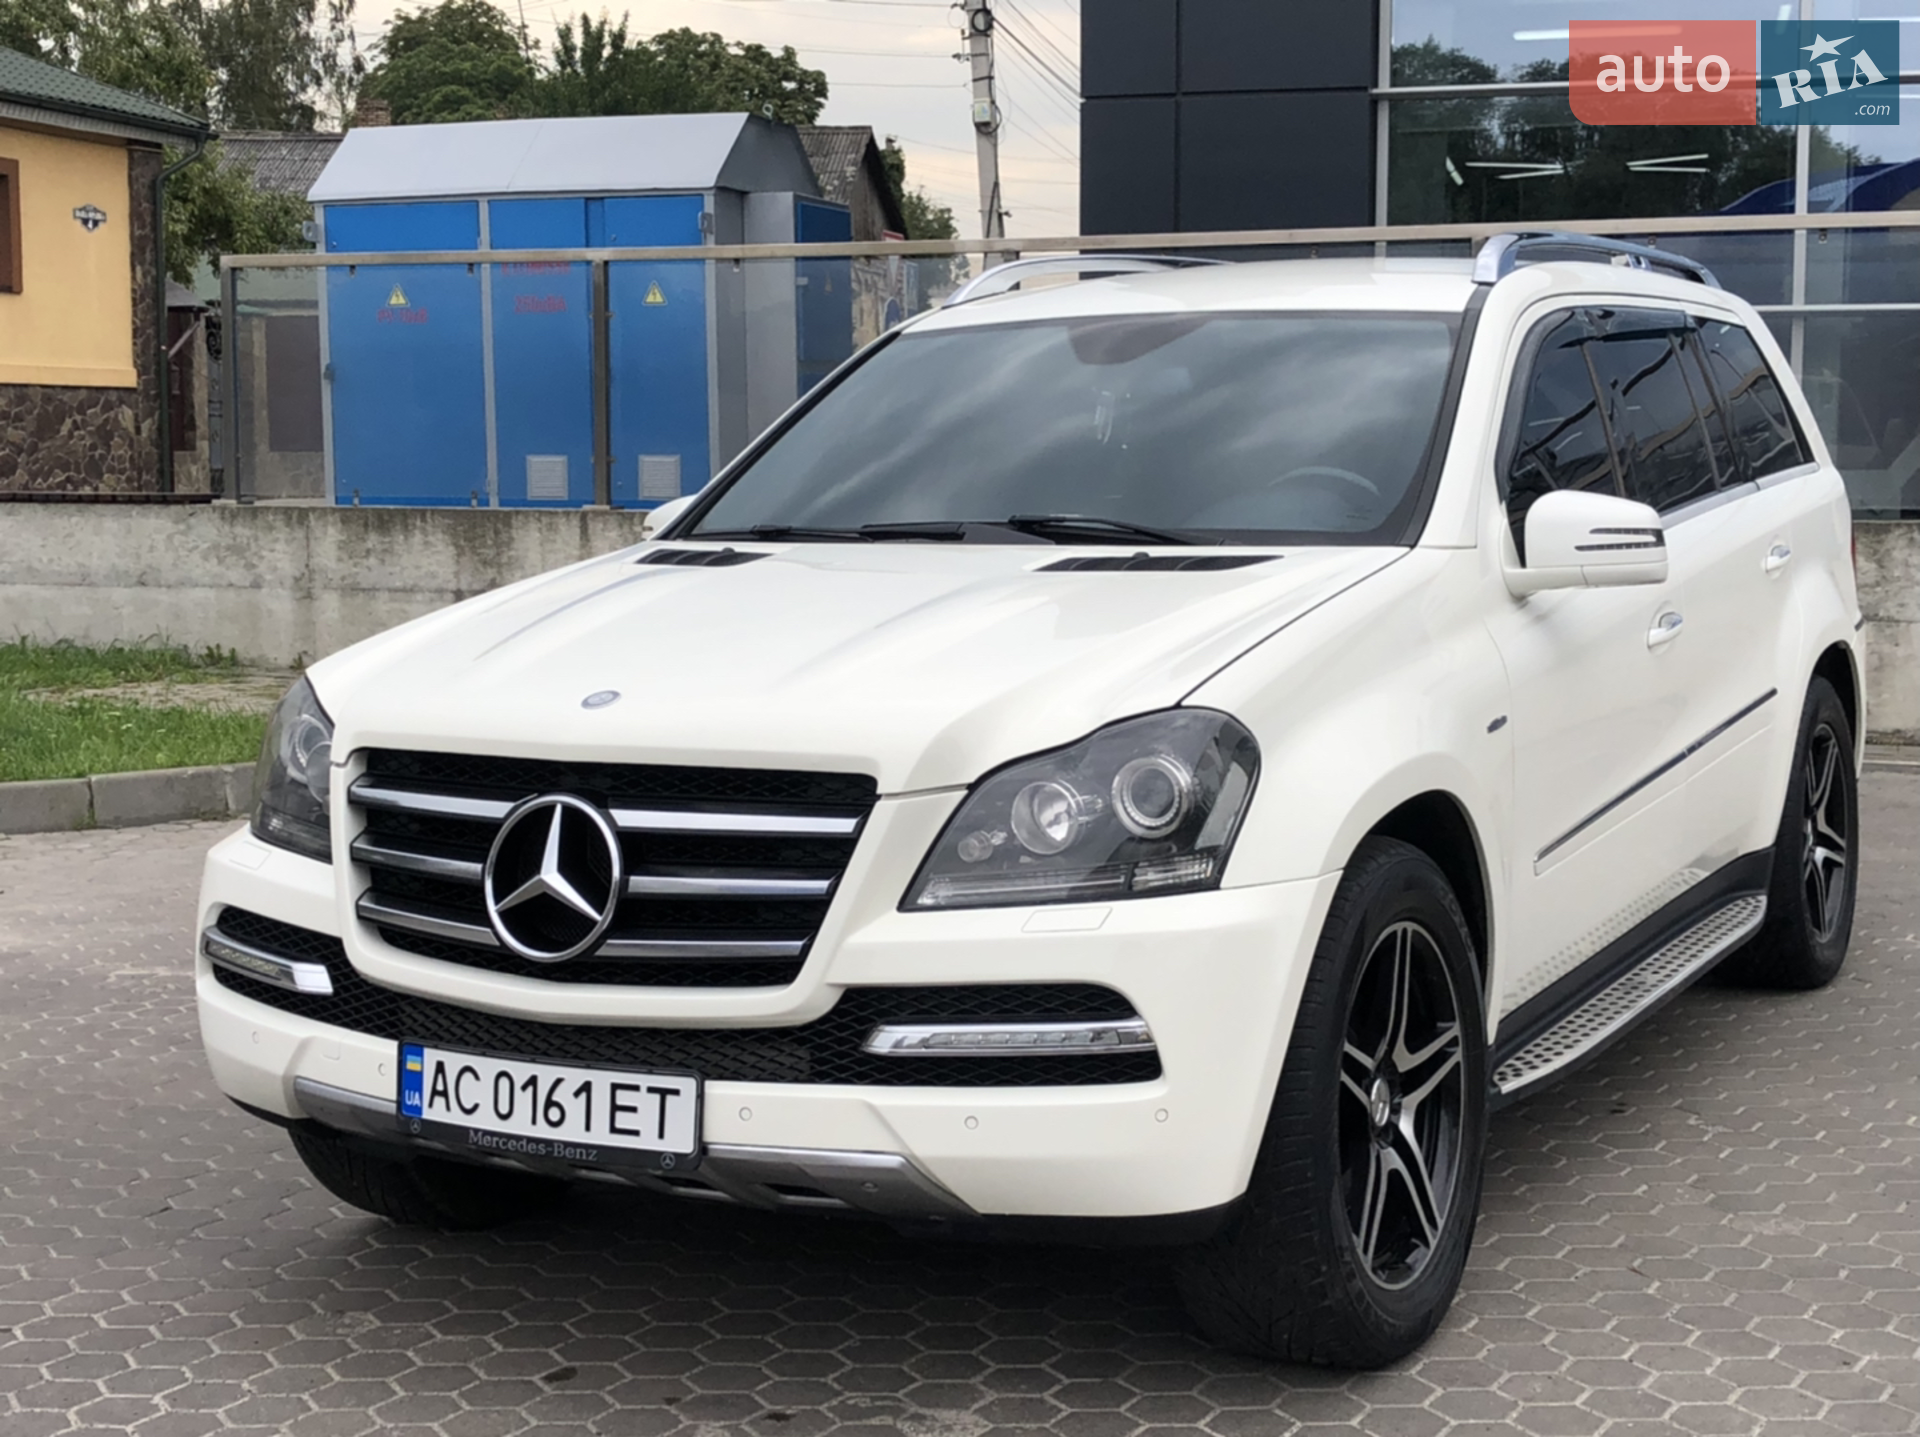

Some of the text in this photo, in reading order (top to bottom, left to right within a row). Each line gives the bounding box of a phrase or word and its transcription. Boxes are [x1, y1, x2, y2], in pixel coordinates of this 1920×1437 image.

[404, 1090, 421, 1107] UA
[428, 1060, 681, 1140] AC 0161 ET
[468, 1129, 598, 1162] Mercedes-Benz
